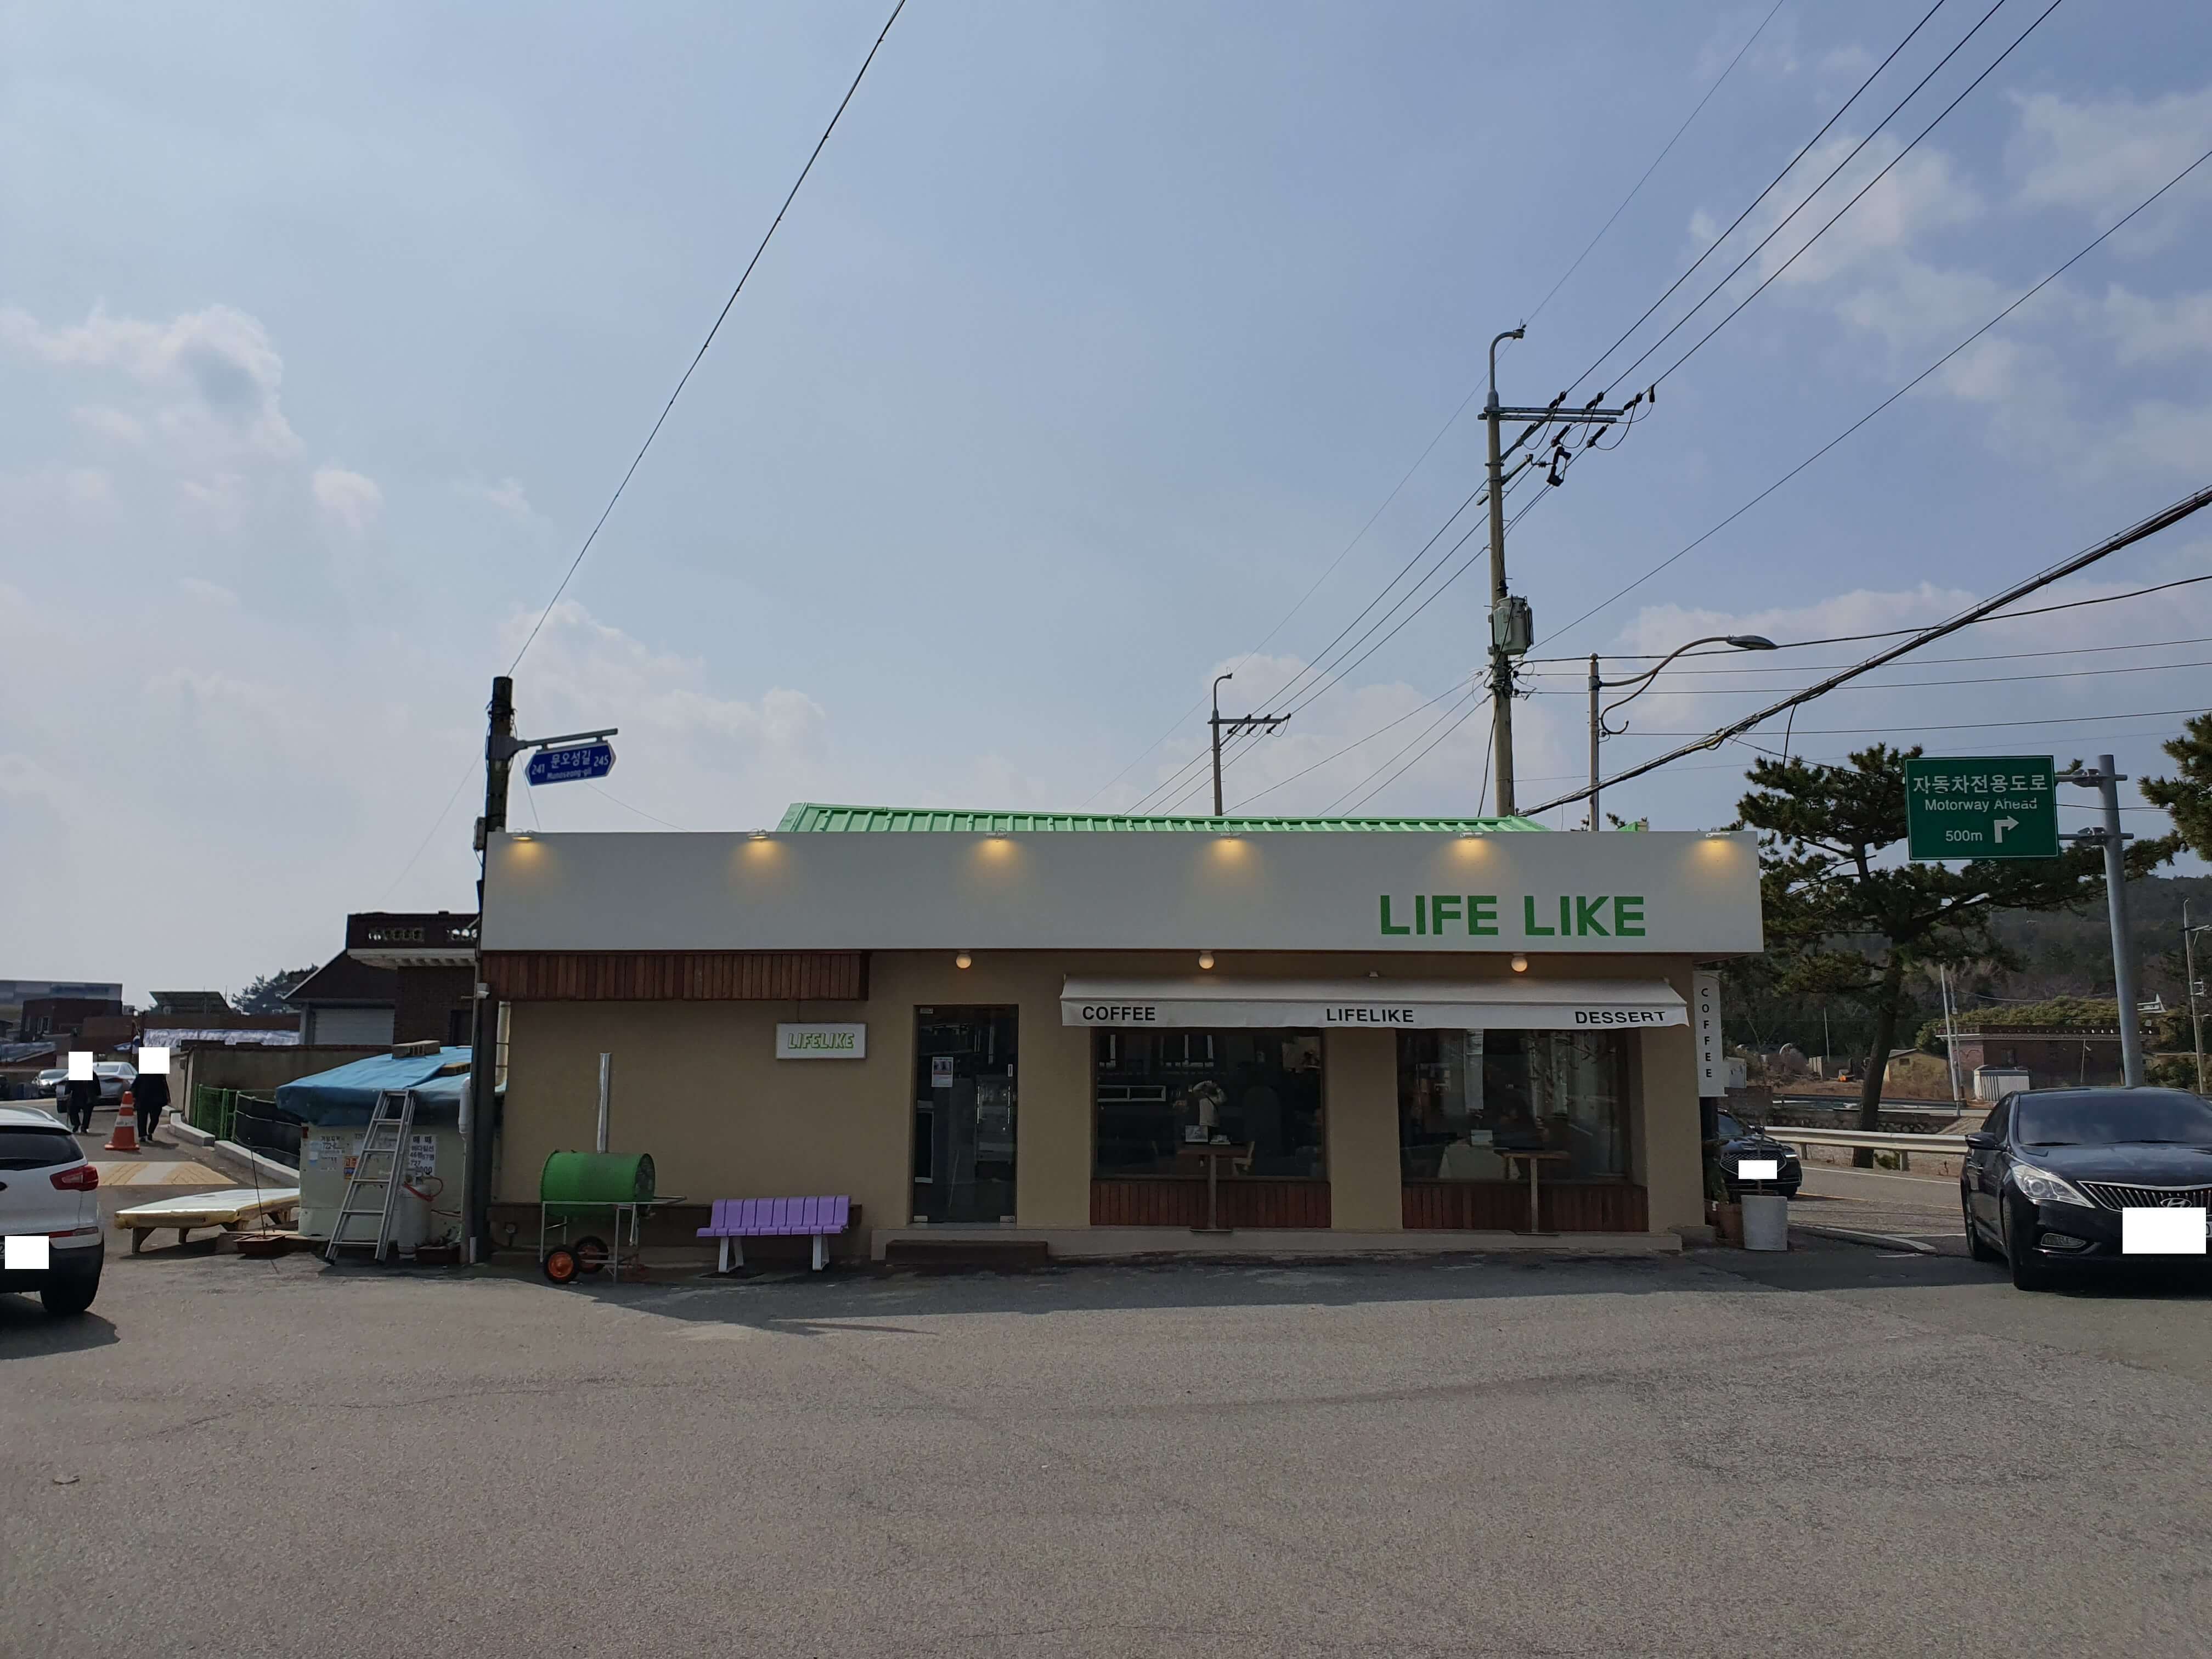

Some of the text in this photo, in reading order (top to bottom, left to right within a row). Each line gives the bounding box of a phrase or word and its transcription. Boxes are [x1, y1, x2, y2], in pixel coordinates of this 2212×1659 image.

[532, 764, 545, 775] 241
[594, 755, 608, 767] 245
[1913, 774, 2048, 794] 자동차전용도로
[1925, 797, 2038, 812] Motorway Ahead
[1945, 830, 1983, 842] 500m
[1380, 895, 1646, 936] LIFE LIKE
[1082, 1006, 1666, 1024] COFFEE LIFELIKE DESSERT
[788, 1032, 855, 1049] LIFELIKE
[1701, 988, 1712, 1077] COFFEE
